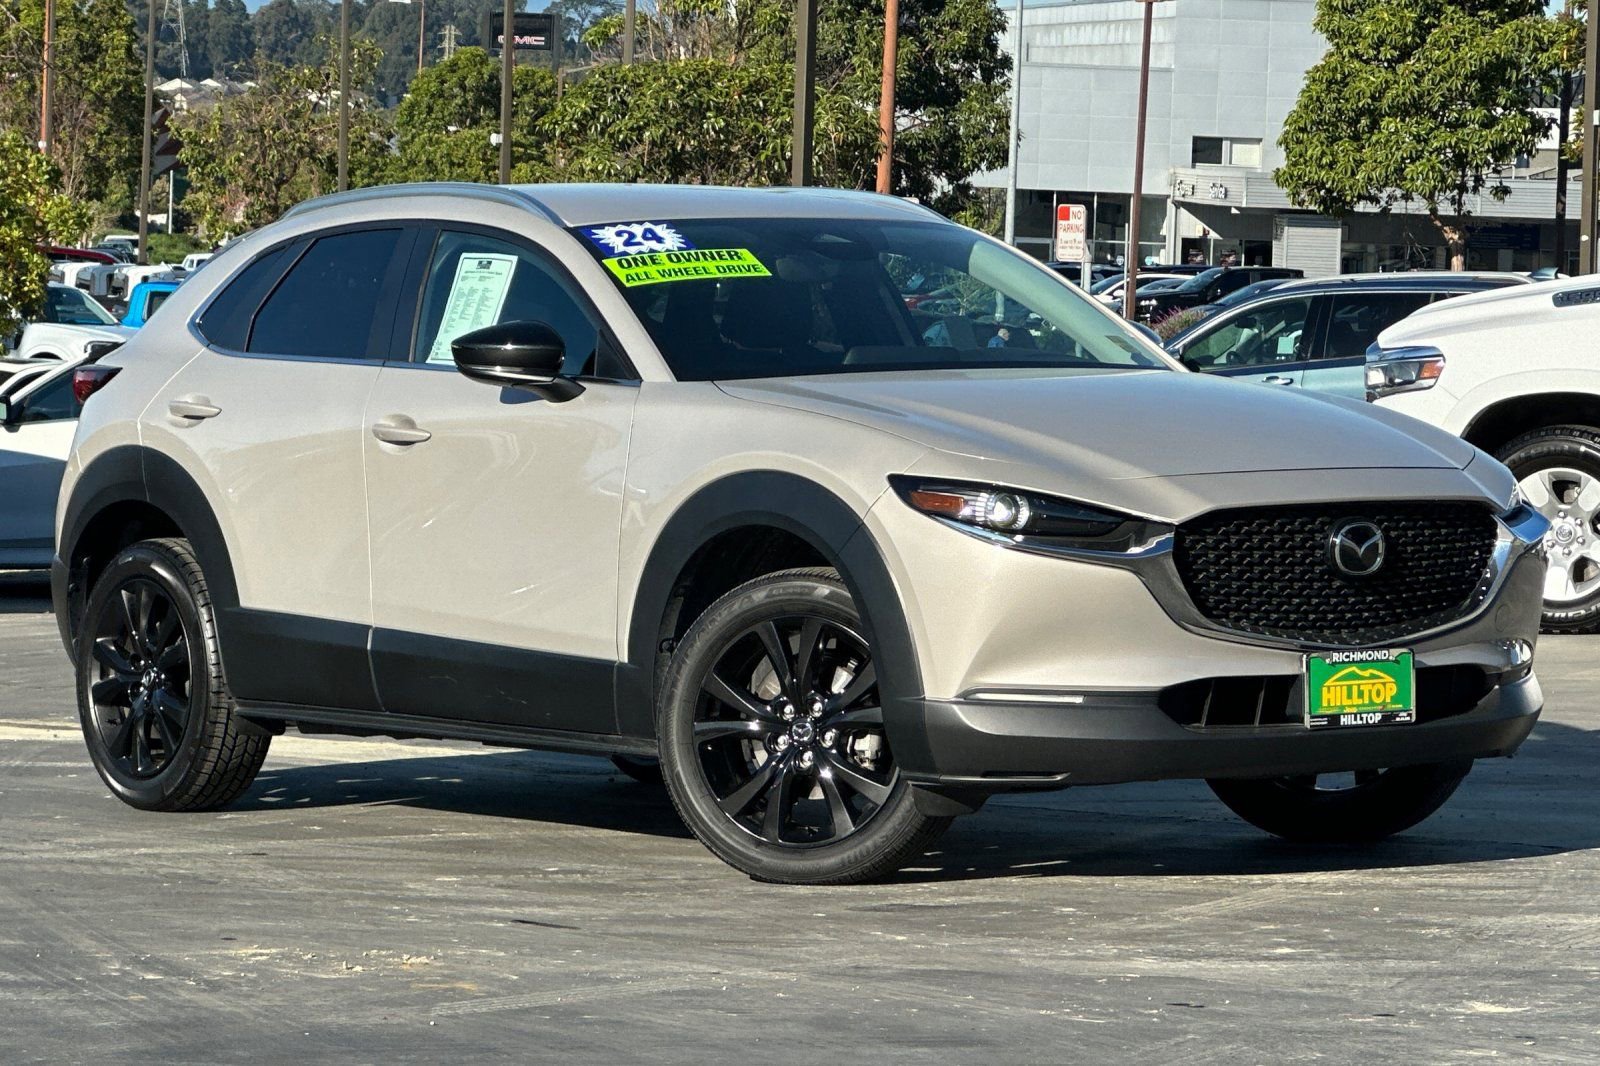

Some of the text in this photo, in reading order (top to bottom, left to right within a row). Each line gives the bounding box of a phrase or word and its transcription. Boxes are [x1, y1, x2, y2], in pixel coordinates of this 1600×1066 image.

[1071, 210, 1082, 220] NO
[1059, 224, 1084, 233] PARKING
[614, 227, 665, 248] 24
[617, 250, 742, 270] ONE OWNER
[625, 263, 763, 283] ALL WHEEL DRIVE
[1332, 650, 1389, 663] RICHMOND
[1322, 683, 1396, 706] HILLTOP
[1341, 713, 1382, 725] HILLTOP
